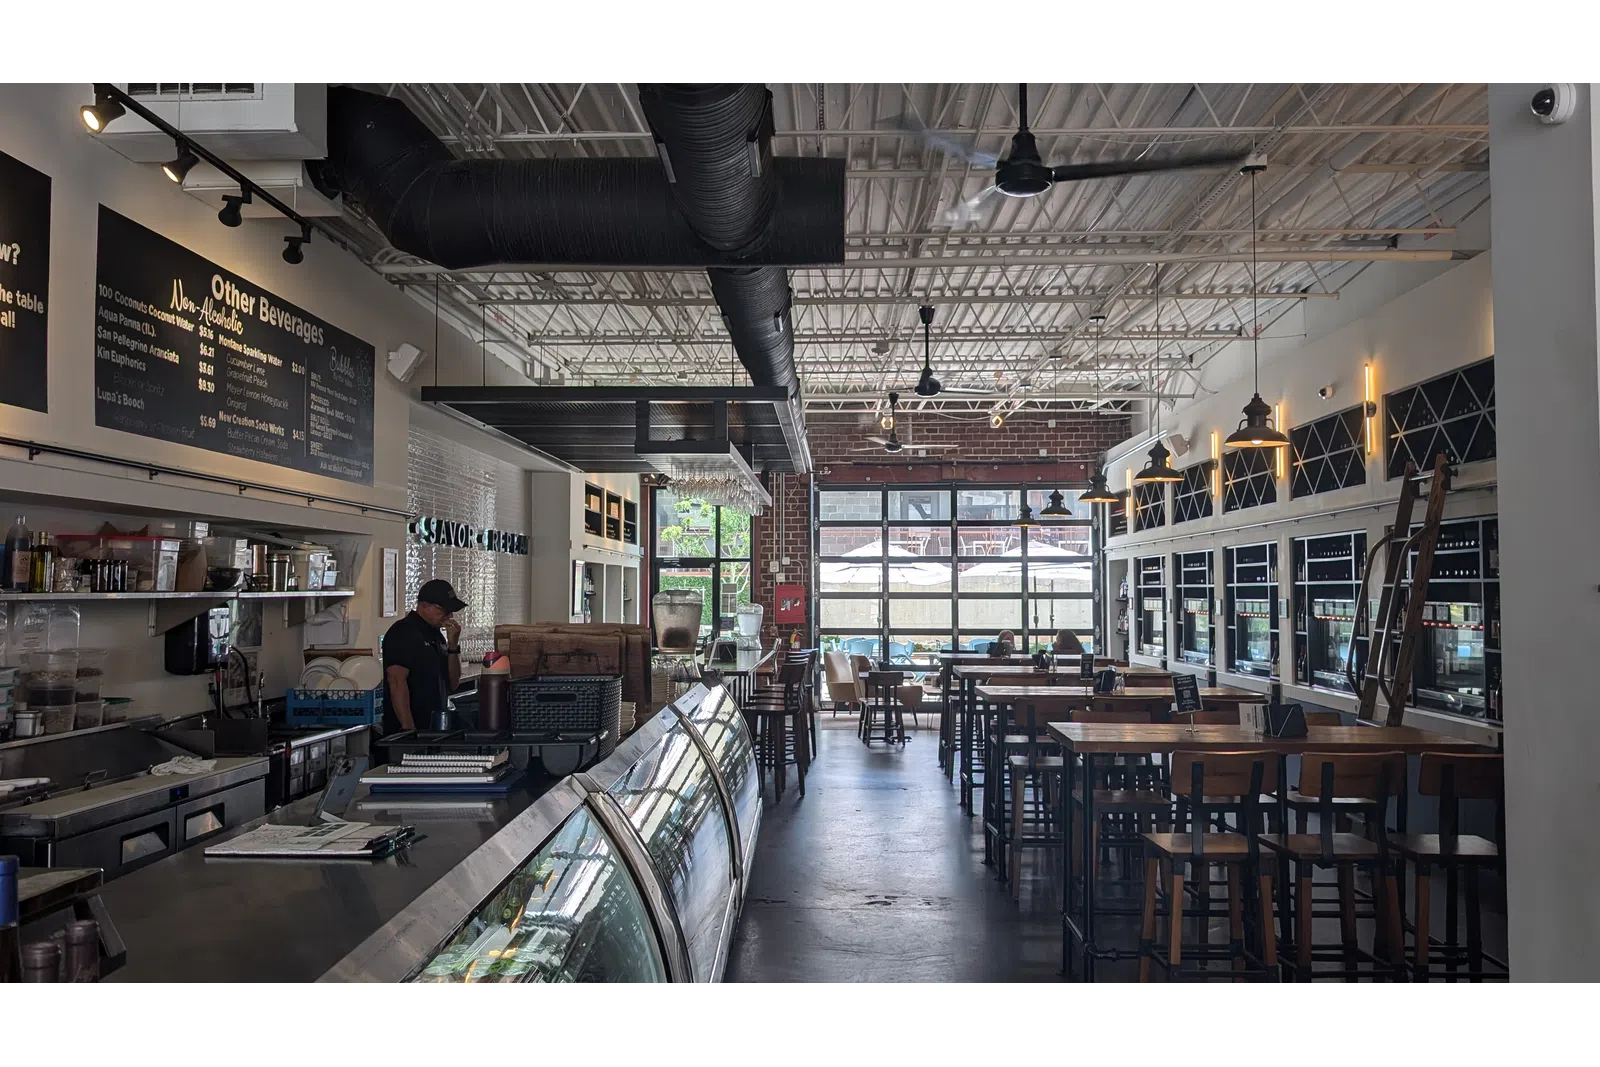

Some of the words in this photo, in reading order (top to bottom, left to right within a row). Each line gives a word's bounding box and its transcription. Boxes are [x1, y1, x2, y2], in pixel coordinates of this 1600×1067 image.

[16, 290, 44, 314] table
[98, 284, 113, 299] 100
[114, 290, 148, 314] Coconuts
[148, 304, 176, 325] Coconut
[175, 315, 195, 332] Water
[170, 278, 244, 336] Non-Alcoholic
[211, 274, 256, 316] Other
[259, 296, 324, 346] Beverages
[98, 306, 118, 323] Aqua
[119, 312, 141, 332] Panna
[97, 325, 112, 341] San
[113, 331, 148, 354] Pellegrino
[149, 344, 180, 364] Aranciata
[97, 345, 110, 361] Kin
[199, 342, 215, 358] $6.21
[218, 333, 242, 353] Montane
[242, 344, 267, 364] Sparkling
[267, 353, 283, 368] Water
[198, 360, 214, 376] $3.61
[226, 353, 253, 371] Cucumber
[253, 364, 266, 376] Lime
[226, 367, 253, 384] Grapefruit
[253, 375, 268, 388] Peach
[97, 387, 122, 405] Lupa's
[122, 393, 145, 411] Booch
[226, 382, 242, 396] Meyer
[243, 388, 260, 400] Lemon
[226, 397, 247, 411] Original
[199, 414, 217, 429] $5.69
[218, 410, 232, 423] New
[232, 414, 255, 428] Creation
[255, 420, 269, 432] Soda
[268, 423, 285, 437] Works
[227, 427, 244, 440] Butter
[244, 432, 260, 444] Pecan
[260, 435, 276, 446] Cream
[276, 438, 289, 450] Soda
[227, 442, 255, 458] Strawberry
[429, 517, 475, 549] SAVOR
